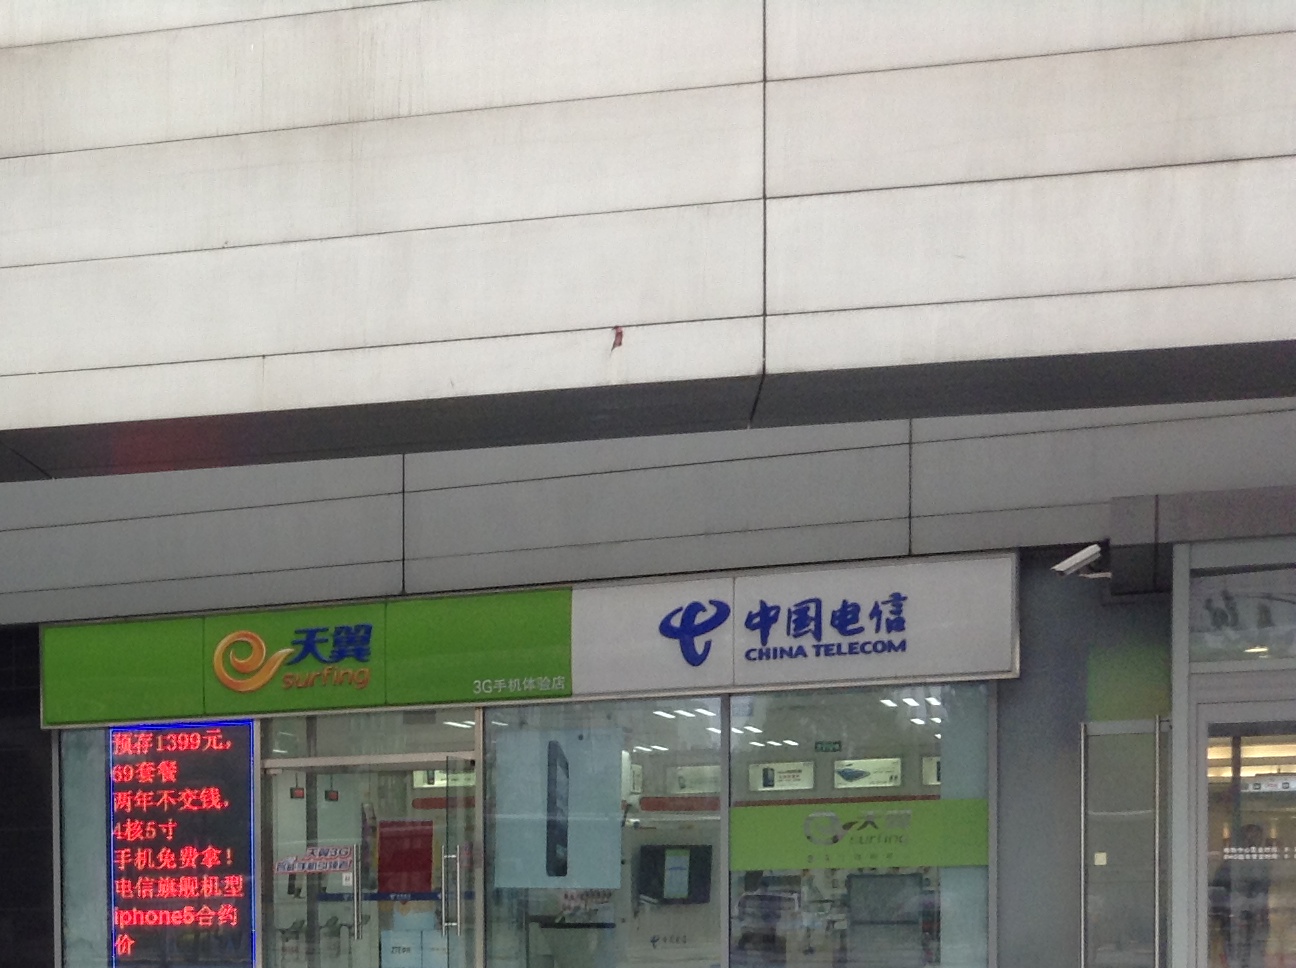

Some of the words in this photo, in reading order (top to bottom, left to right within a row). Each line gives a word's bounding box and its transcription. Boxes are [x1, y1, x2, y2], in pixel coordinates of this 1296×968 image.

[745, 592, 908, 645] 中国电信
[286, 624, 372, 665] 天翼
[745, 644, 807, 661] CHINA
[812, 639, 907, 657] TELECOM
[282, 666, 370, 690] surfing
[473, 676, 566, 695] 3G手机体验店
[112, 760, 177, 783] 69套餐
[113, 818, 177, 841] 4核5寸
[115, 875, 244, 898] 电信旗舰机型
[115, 934, 135, 956] 价
